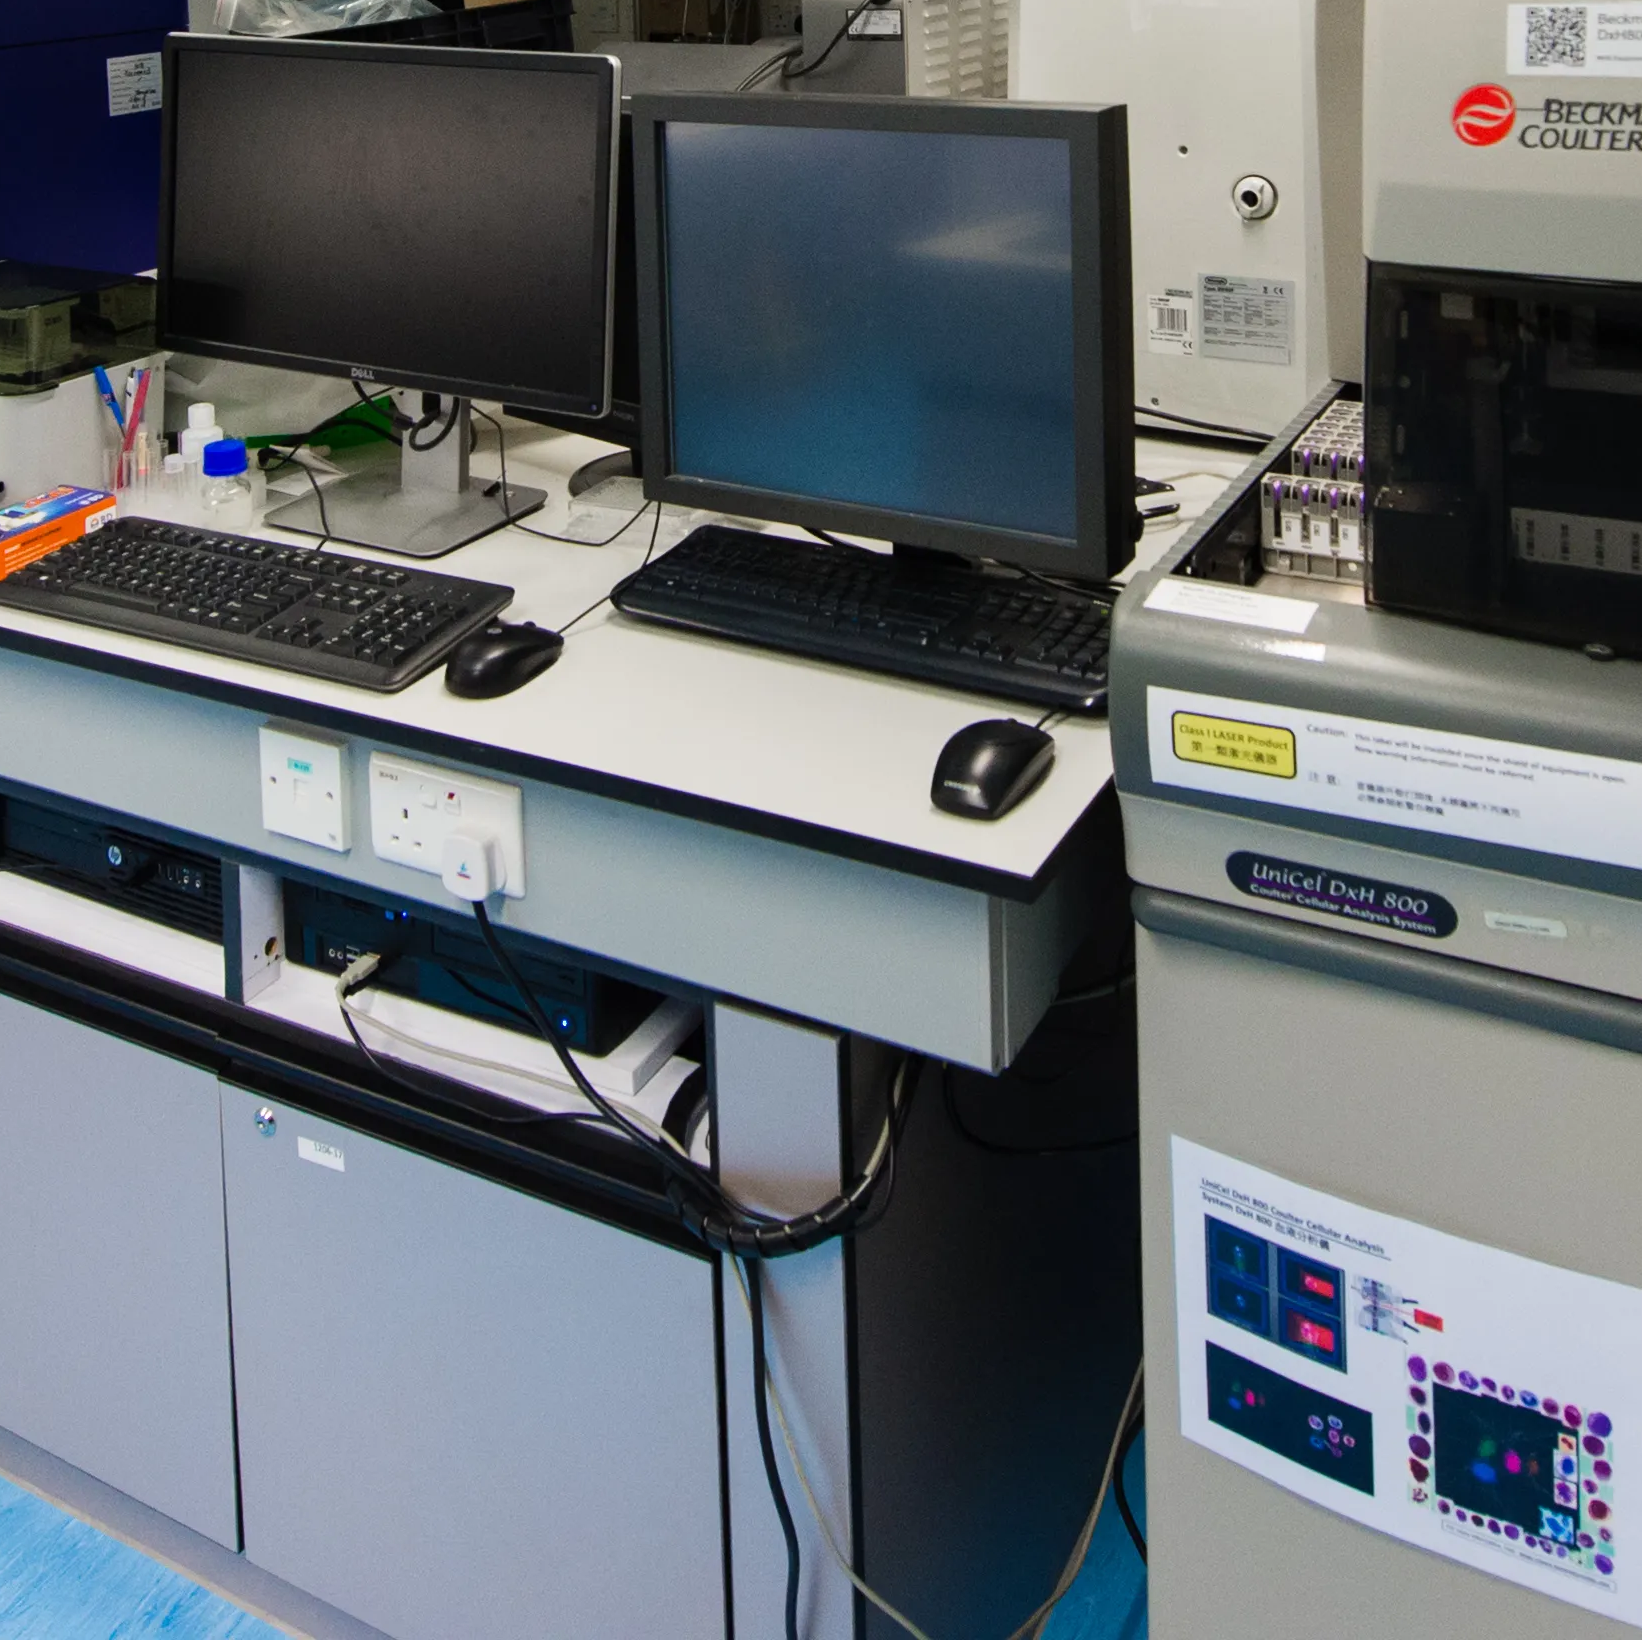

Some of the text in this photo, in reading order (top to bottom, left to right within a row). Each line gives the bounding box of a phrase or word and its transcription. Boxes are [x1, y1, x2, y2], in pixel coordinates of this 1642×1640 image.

[351, 367, 375, 380] DELL
[1179, 724, 1205, 737] Class
[1213, 730, 1245, 742] LASER
[1247, 735, 1289, 750] Product
[1250, 882, 1437, 935] Coulter Cellular Analysis System
[1252, 862, 1429, 916] UniCel DxH 800
[1201, 1178, 1385, 1255] UniCel DxH 800 Coulter Cellular Analysis
[1202, 1192, 1234, 1211] System
[1236, 1205, 1254, 1220] DxH
[1256, 1214, 1273, 1228] 800
